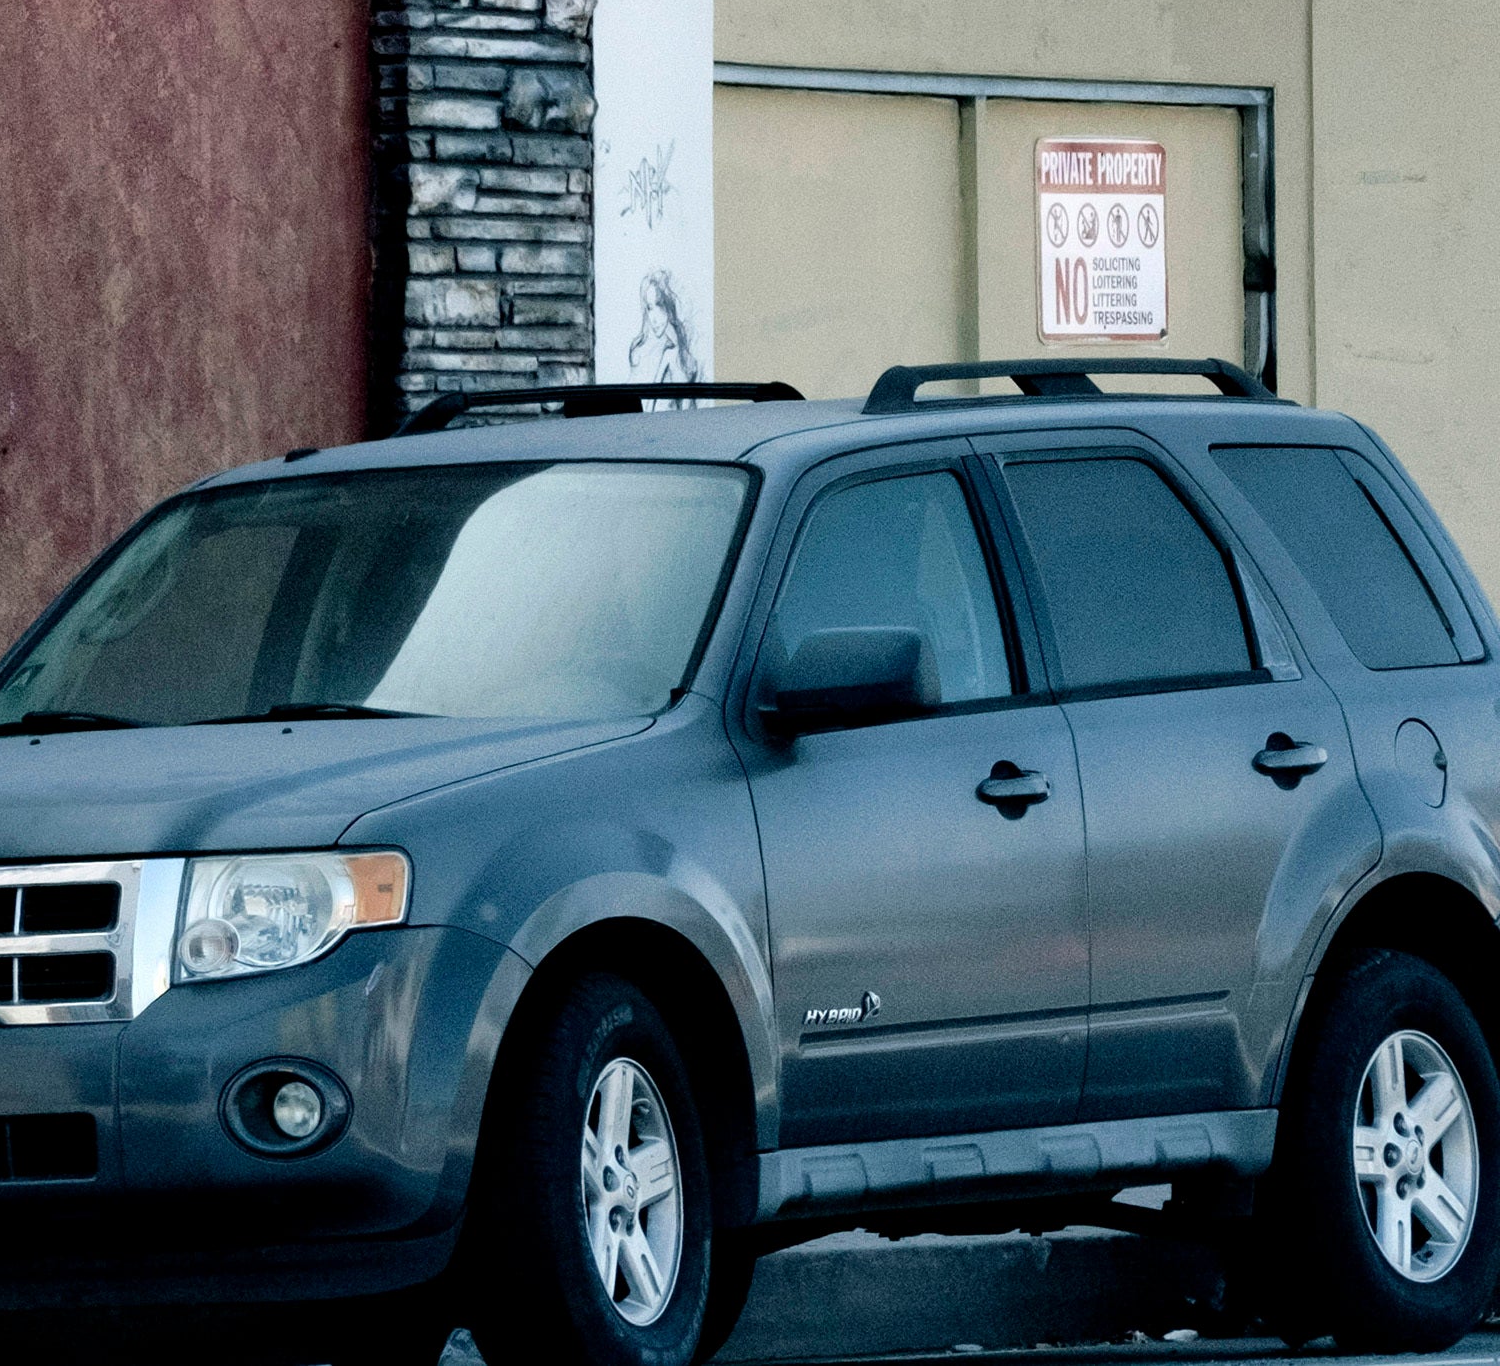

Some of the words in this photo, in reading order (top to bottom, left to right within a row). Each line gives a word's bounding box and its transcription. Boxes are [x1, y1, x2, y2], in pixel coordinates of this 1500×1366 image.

[1041, 151, 1094, 185] PRIVATE
[1097, 152, 1162, 186] PROPERTY
[1092, 257, 1140, 271] SOLICITING
[1092, 275, 1138, 289] LOITERING
[1055, 256, 1089, 325] NO
[1092, 293, 1137, 307] LITTERING
[1093, 311, 1154, 325] TRESPASSING
[804, 1007, 861, 1024] HYBRID
